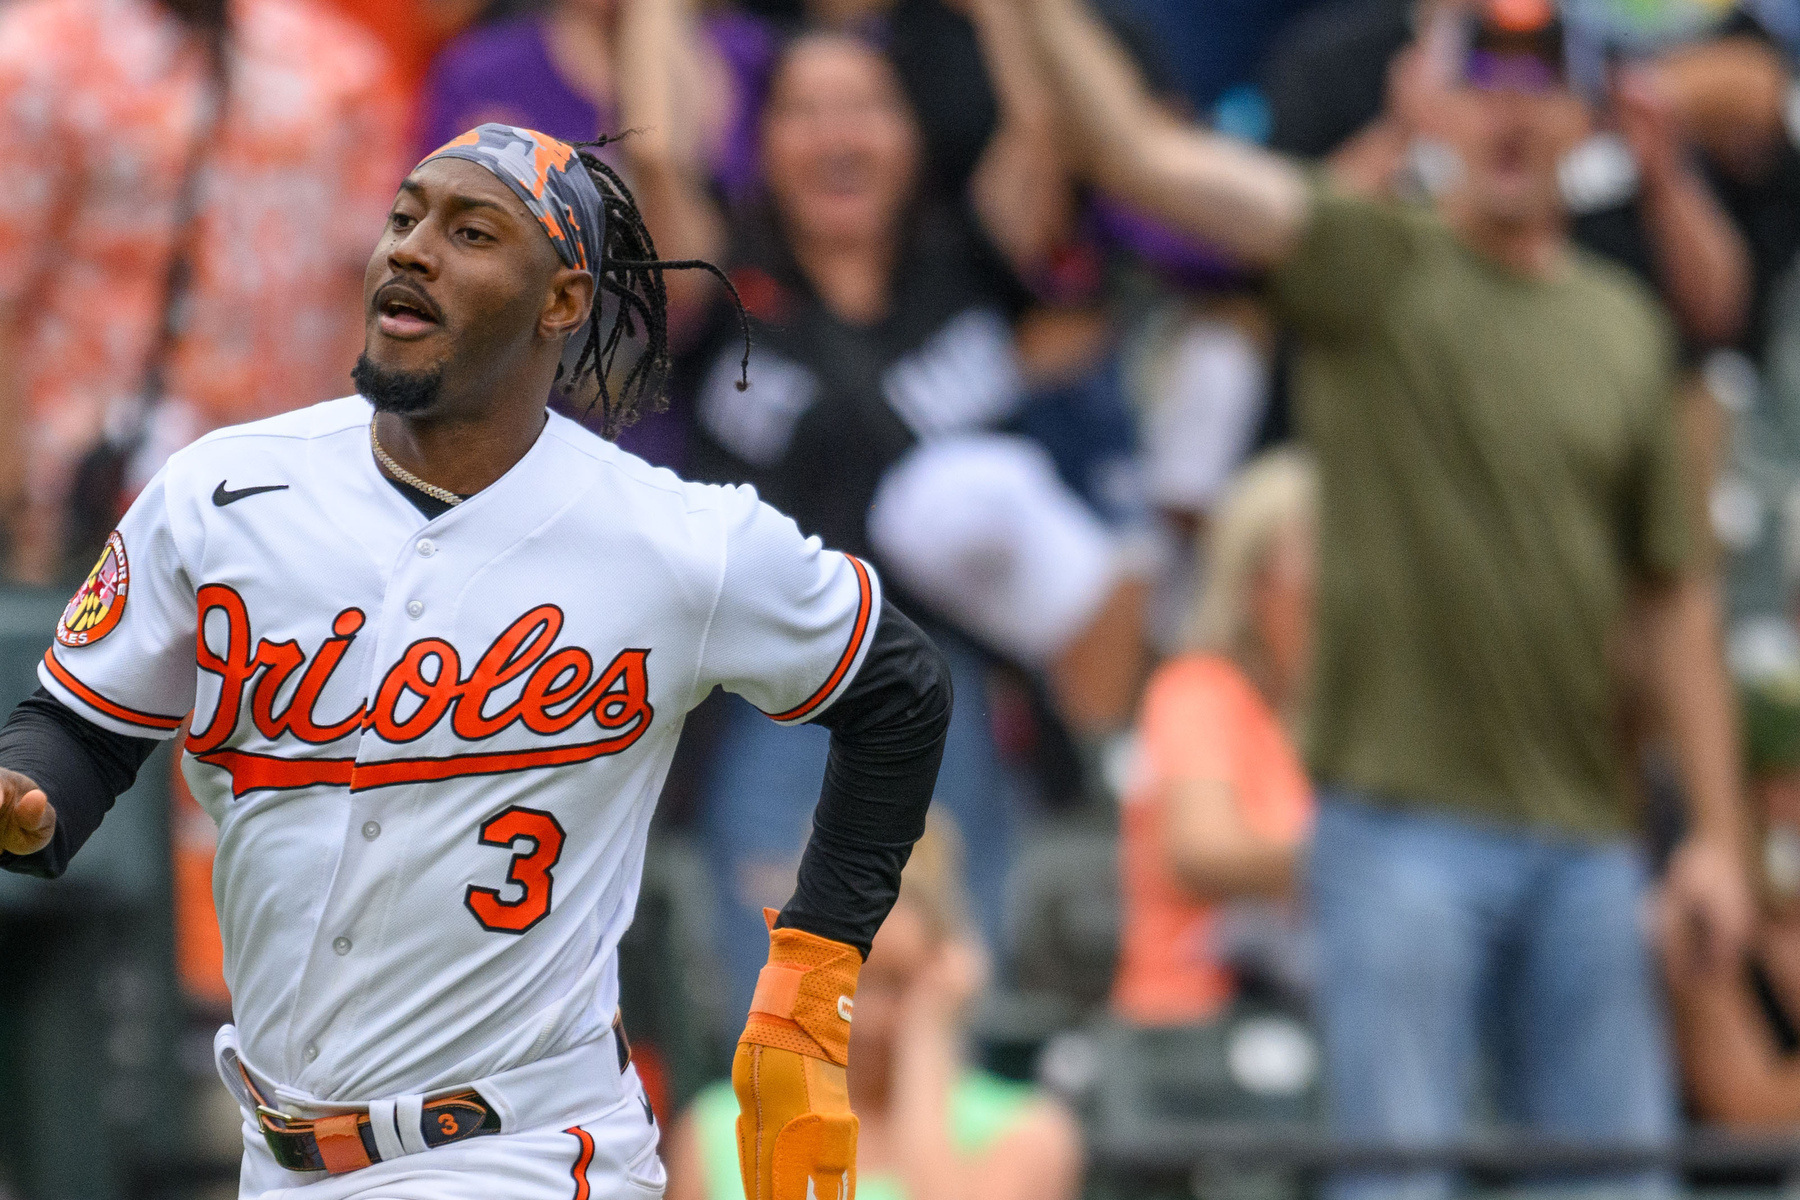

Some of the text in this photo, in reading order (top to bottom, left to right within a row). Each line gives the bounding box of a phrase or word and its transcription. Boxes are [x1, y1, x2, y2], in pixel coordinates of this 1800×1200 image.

[184, 582, 654, 746] Orioles
[465, 804, 567, 936] 3
[438, 1113, 459, 1136] 3
